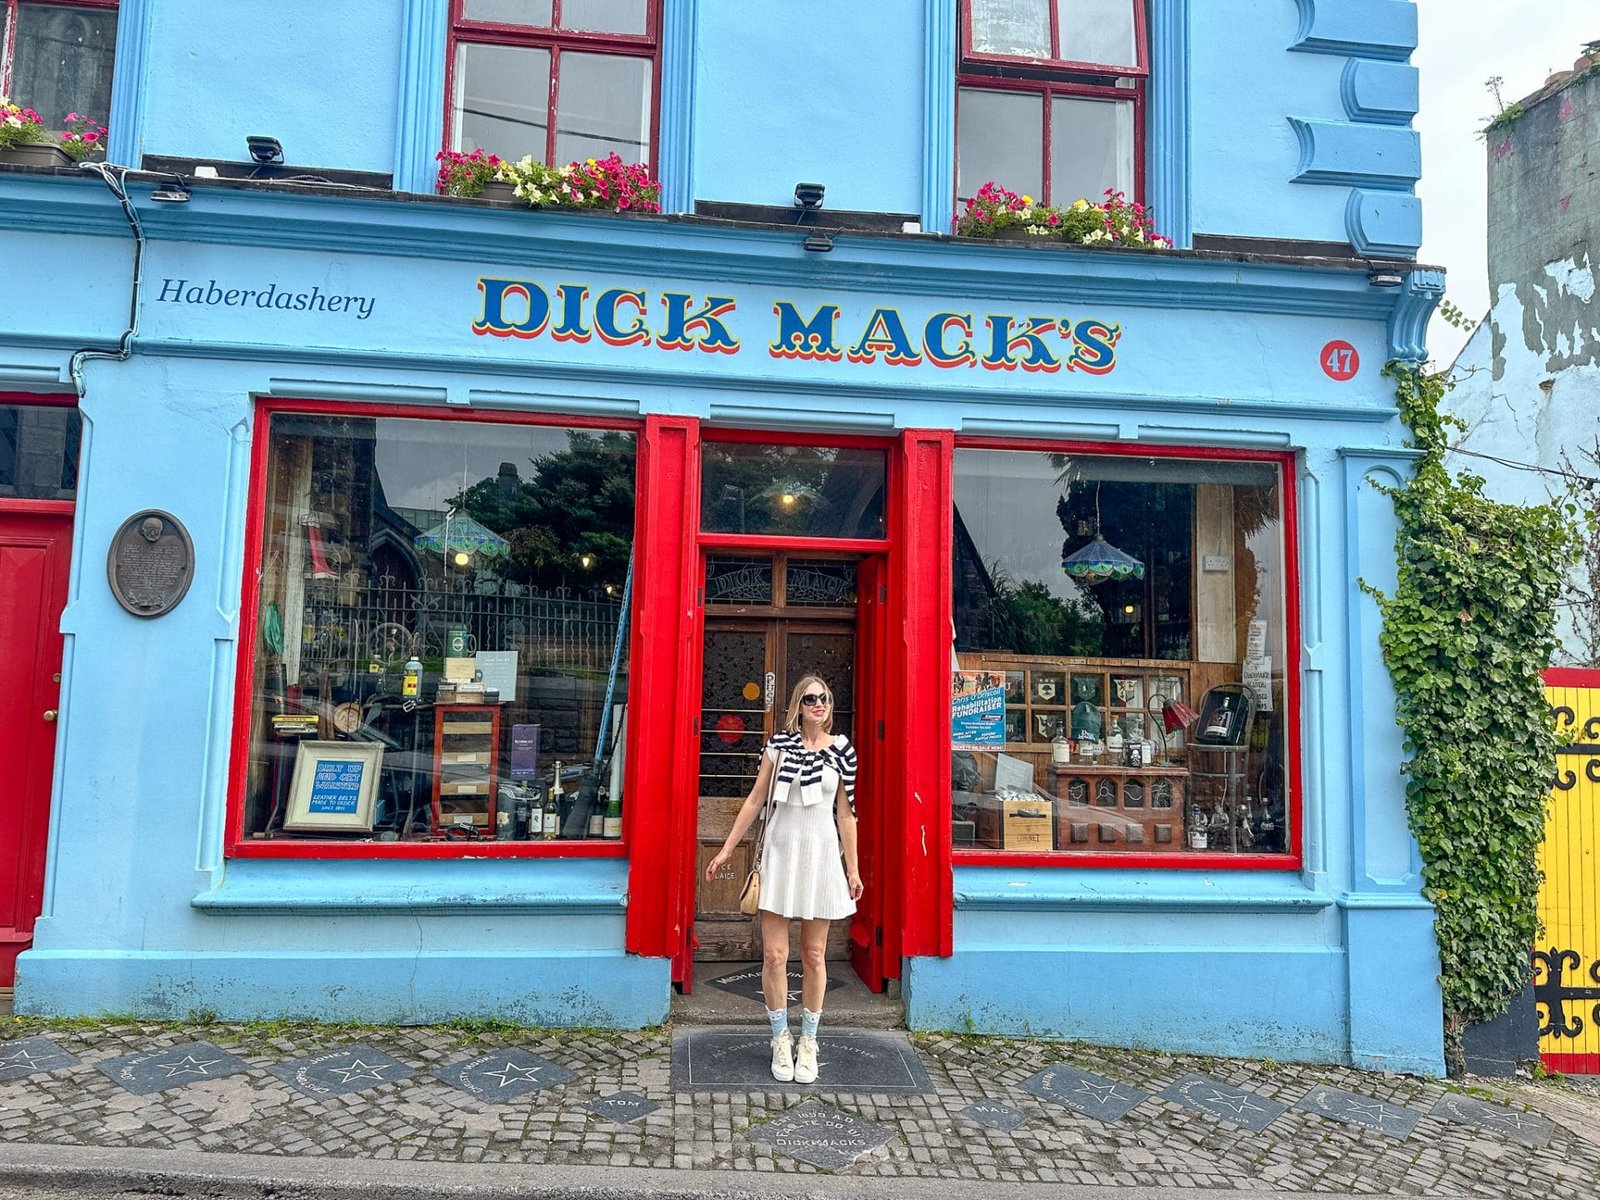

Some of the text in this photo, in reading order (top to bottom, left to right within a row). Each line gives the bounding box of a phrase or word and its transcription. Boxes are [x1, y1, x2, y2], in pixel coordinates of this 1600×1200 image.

[156, 278, 376, 320] Haberdashery
[471, 276, 1122, 376] DICK MACK'S
[1326, 348, 1353, 373] 47
[716, 568, 764, 594] DICK
[952, 696, 1002, 713] Rehabilitation
[952, 703, 1002, 719] FUNDRAISER
[317, 764, 343, 772] BELT
[339, 773, 360, 781] GET
[716, 972, 762, 985] MICHAE
[312, 1051, 351, 1065] JONES
[604, 1099, 640, 1107] TOM
[1050, 1092, 1085, 1110] DOLLY
[975, 1106, 1009, 1114] MAC
